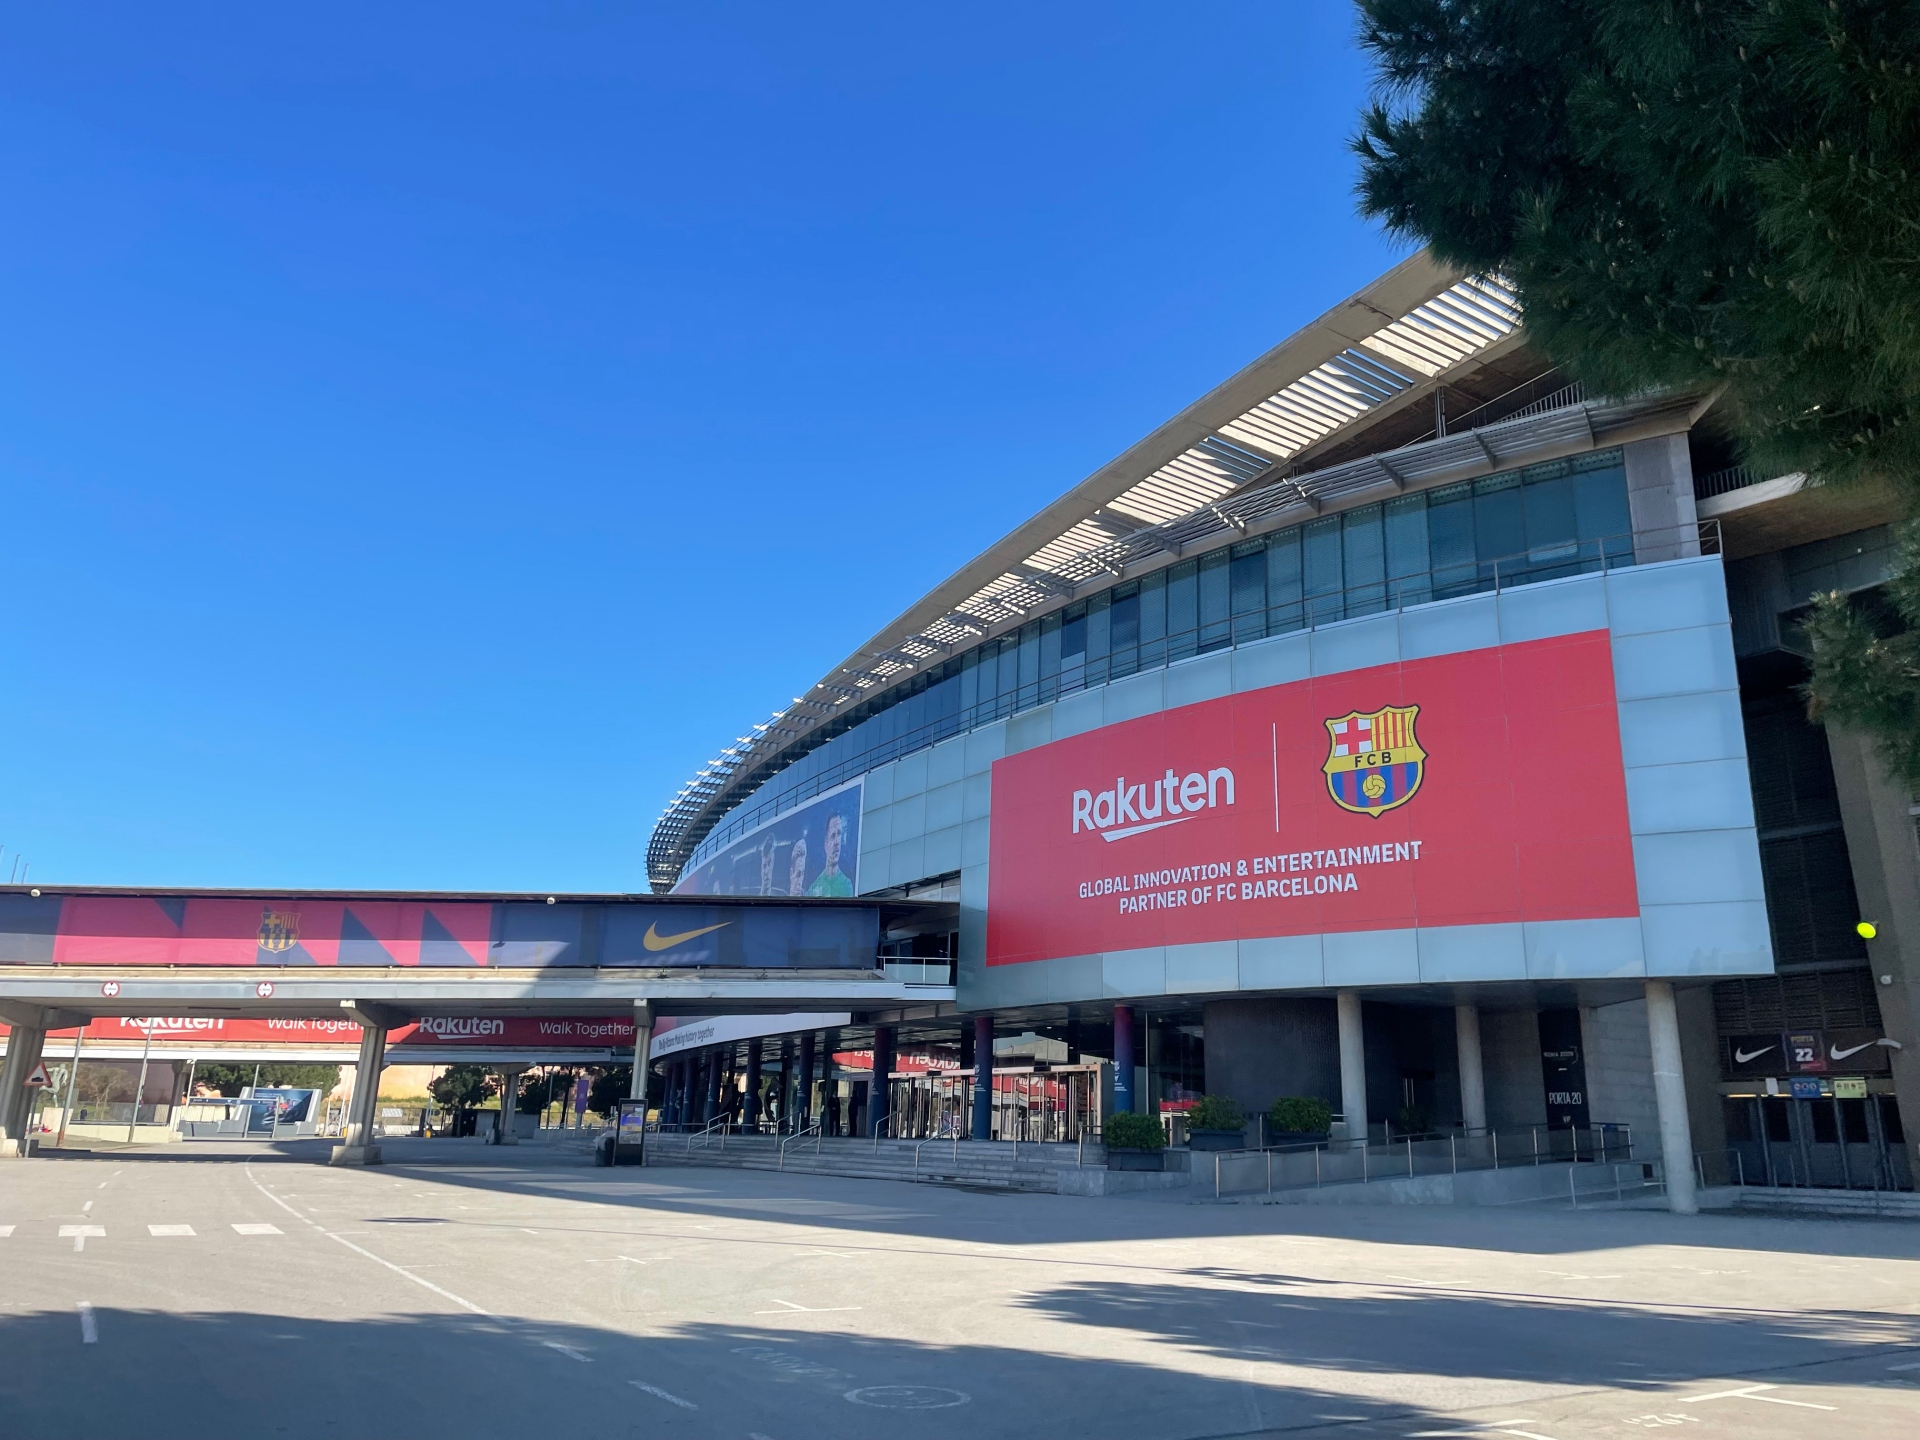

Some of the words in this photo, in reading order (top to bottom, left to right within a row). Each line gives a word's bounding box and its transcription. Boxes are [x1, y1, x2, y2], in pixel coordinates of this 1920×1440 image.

[1354, 751, 1392, 768] FCB
[1072, 766, 1235, 834] Rakuten
[1079, 875, 1131, 899] GLOBAL
[1133, 861, 1231, 890] INNOVATION
[1236, 859, 1248, 877] &
[1253, 840, 1422, 875] ENTERTAINMENT
[1119, 889, 1188, 915] PARTNER
[1191, 885, 1213, 905] OF
[1216, 882, 1237, 902] FC
[1241, 872, 1359, 900] BARCELONA
[419, 1017, 504, 1035] Rakuten
[539, 1022, 573, 1035] Walk
[575, 1022, 636, 1038] Together
[1795, 1047, 1814, 1062] 22
[1549, 1092, 1571, 1104] PORTA
[1571, 1092, 1581, 1104] 20
